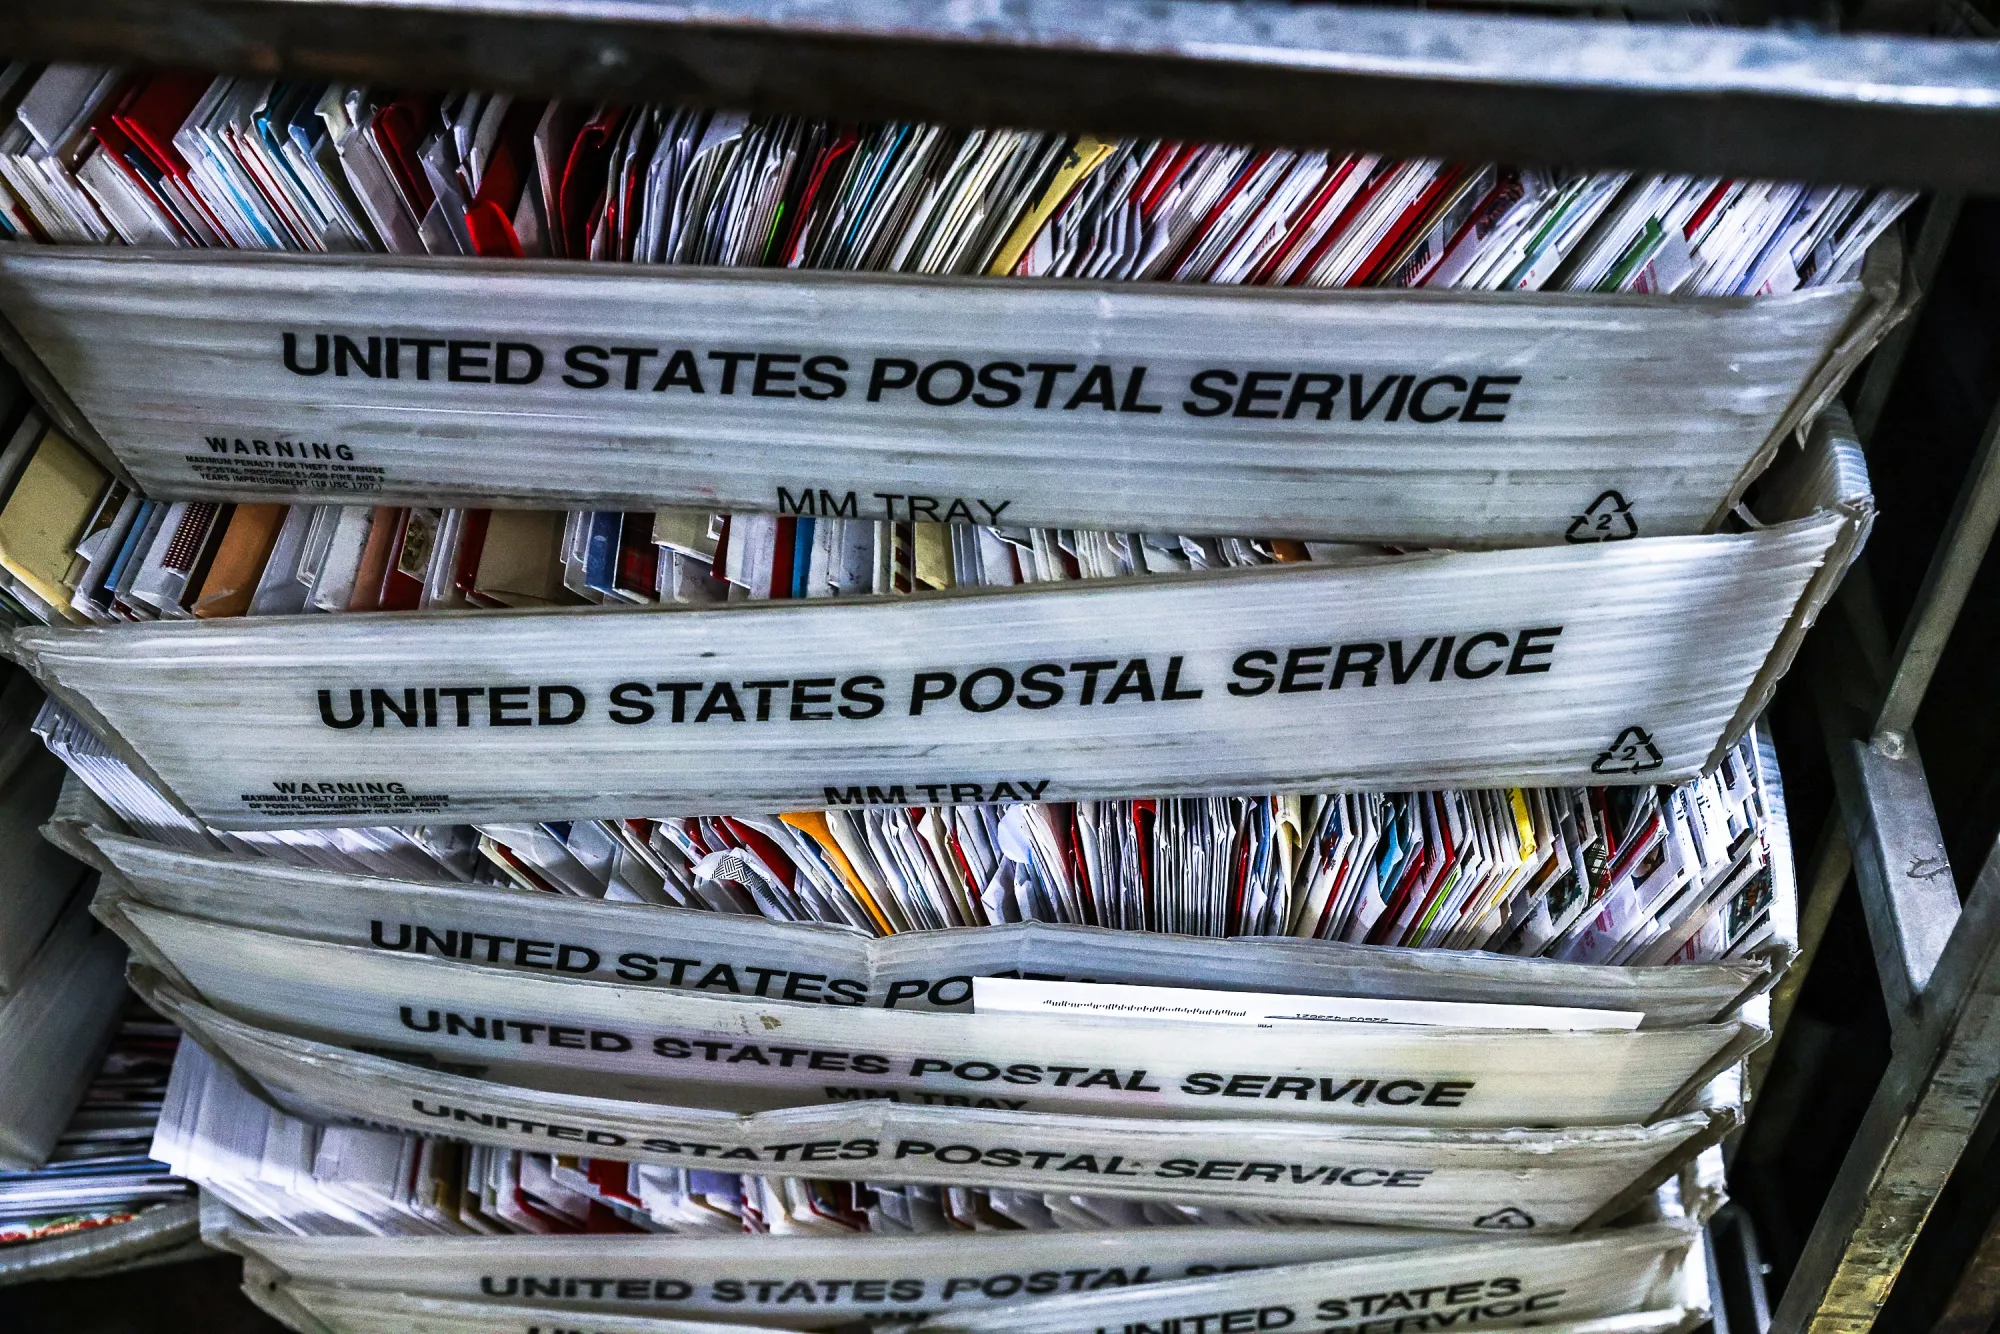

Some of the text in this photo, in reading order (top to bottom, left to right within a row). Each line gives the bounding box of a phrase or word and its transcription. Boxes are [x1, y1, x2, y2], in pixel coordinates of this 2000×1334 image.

[282, 332, 1523, 423] UNITED STATES POSTAL SERVICE
[205, 437, 354, 461] WARNING
[185, 455, 385, 474] MAXIMUM PENALTY FOR THEFT OR MISUSE
[331, 473, 352, 481] FINE
[200, 473, 230, 481] YEARS
[312, 480, 327, 488] (18
[330, 481, 349, 489] USC
[777, 487, 1011, 526] MM TRAY
[1596, 514, 1612, 530] 2
[318, 625, 1564, 729] UNITED STATES POSTAL SERVICE
[1621, 746, 1637, 761] 2
[272, 782, 407, 795] WARNING
[823, 780, 1050, 805] MM TRAY
[371, 920, 600, 974] UNITED
[616, 952, 868, 1007] STATES
[400, 1006, 1475, 1108] UNITED STATES POSTAL SERVICE
[413, 1099, 626, 1147] UNITED
[642, 1139, 879, 1162] STATES
[895, 1139, 1138, 1176] POSTAL
[1155, 1159, 1434, 1188] SERVICE
[480, 1276, 693, 1302] UNITED
[711, 1278, 924, 1303] STATES
[1316, 1276, 1521, 1321] STATES
